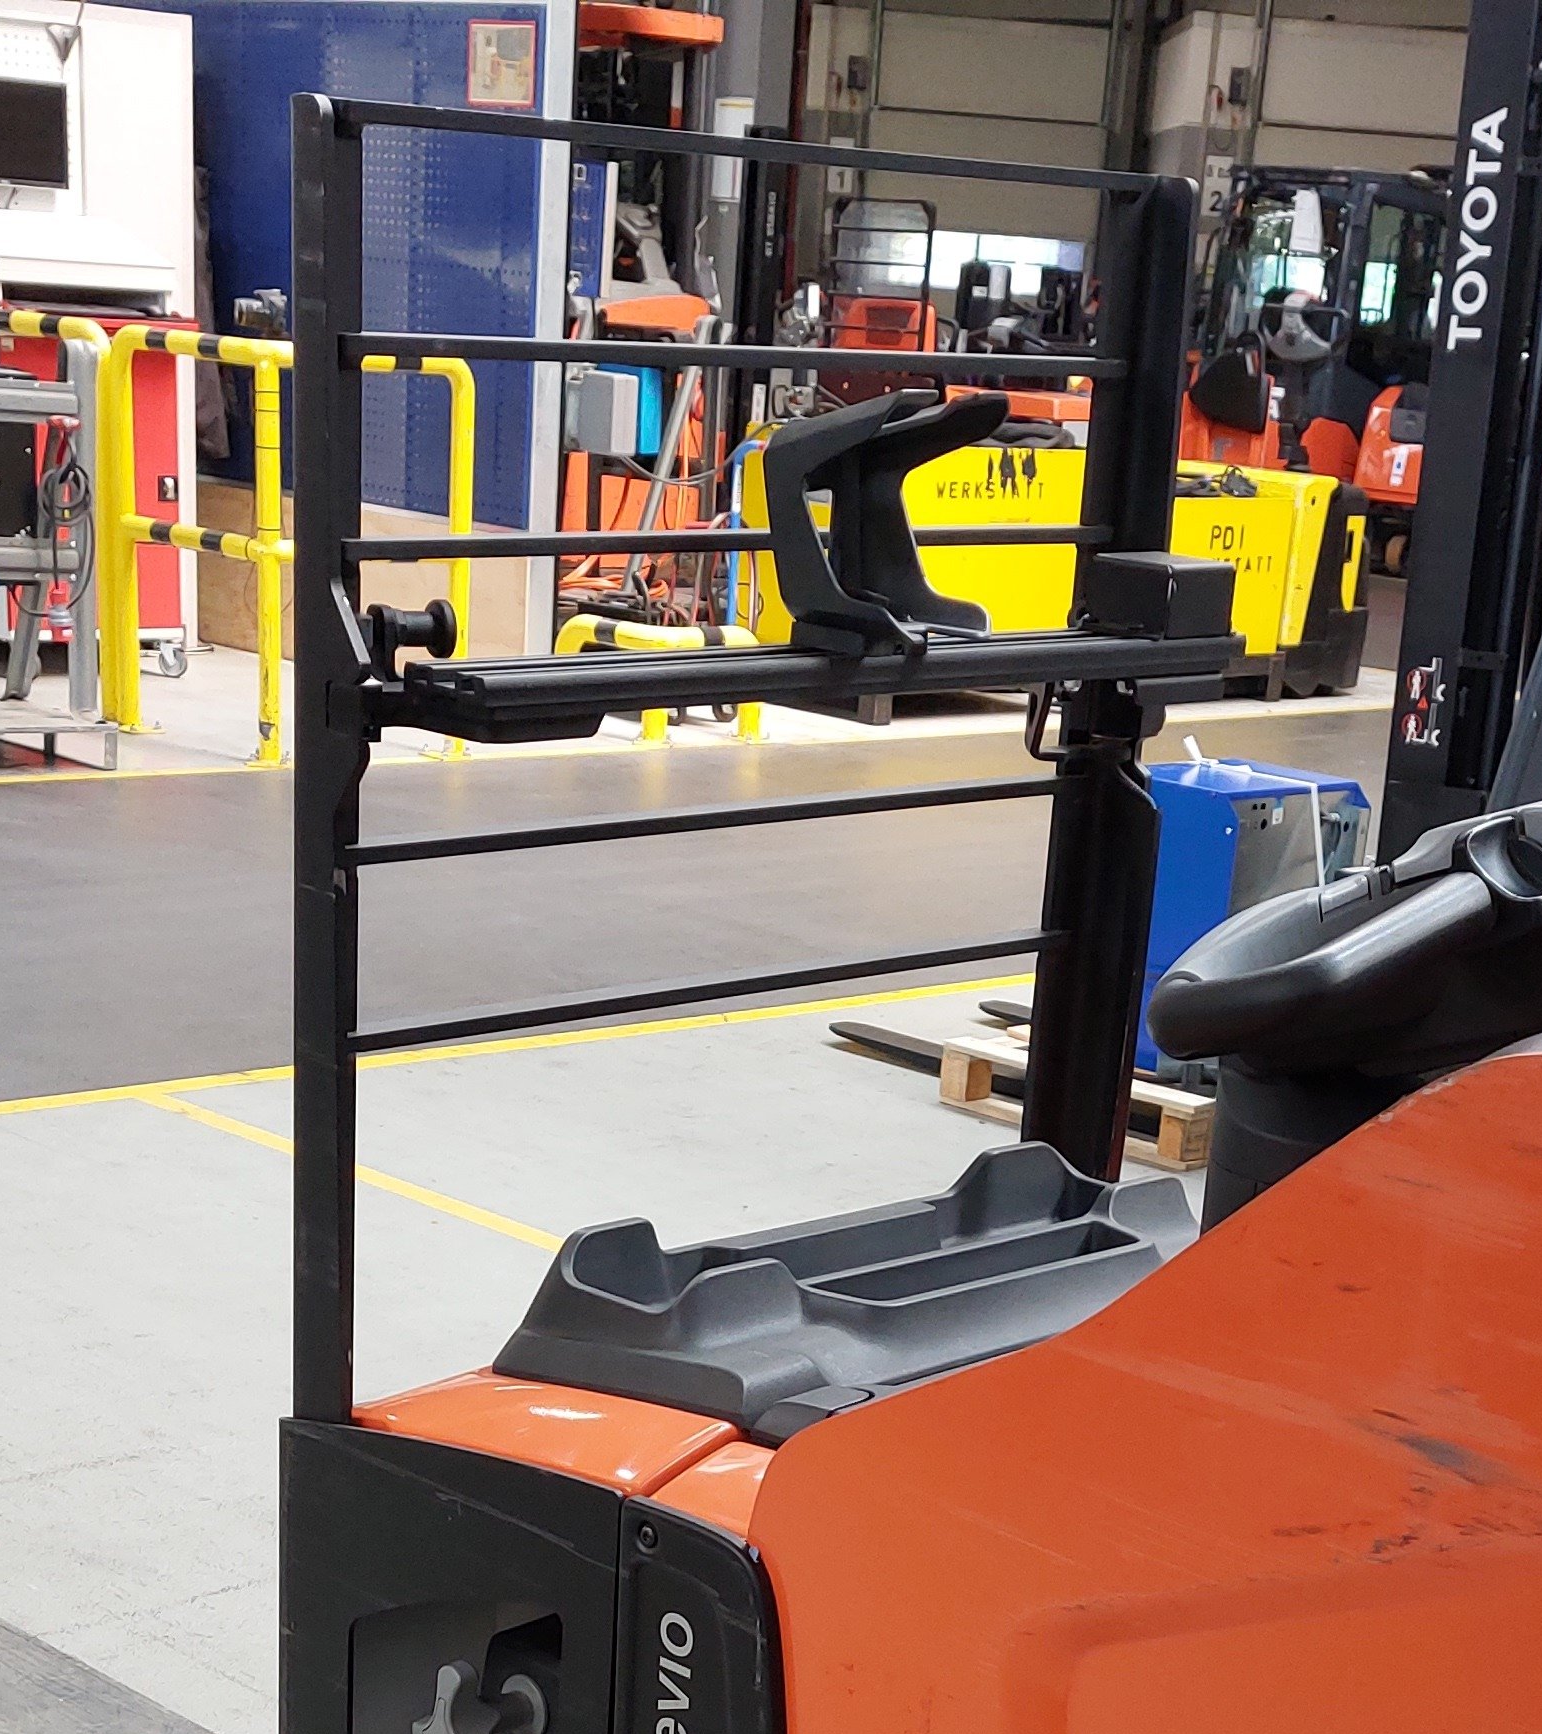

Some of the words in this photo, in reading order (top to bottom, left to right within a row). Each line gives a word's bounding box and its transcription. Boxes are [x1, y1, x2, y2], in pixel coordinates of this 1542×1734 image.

[1209, 190, 1223, 212] 2
[1446, 107, 1509, 351] TOYOTA
[1210, 524, 1245, 550] PDI
